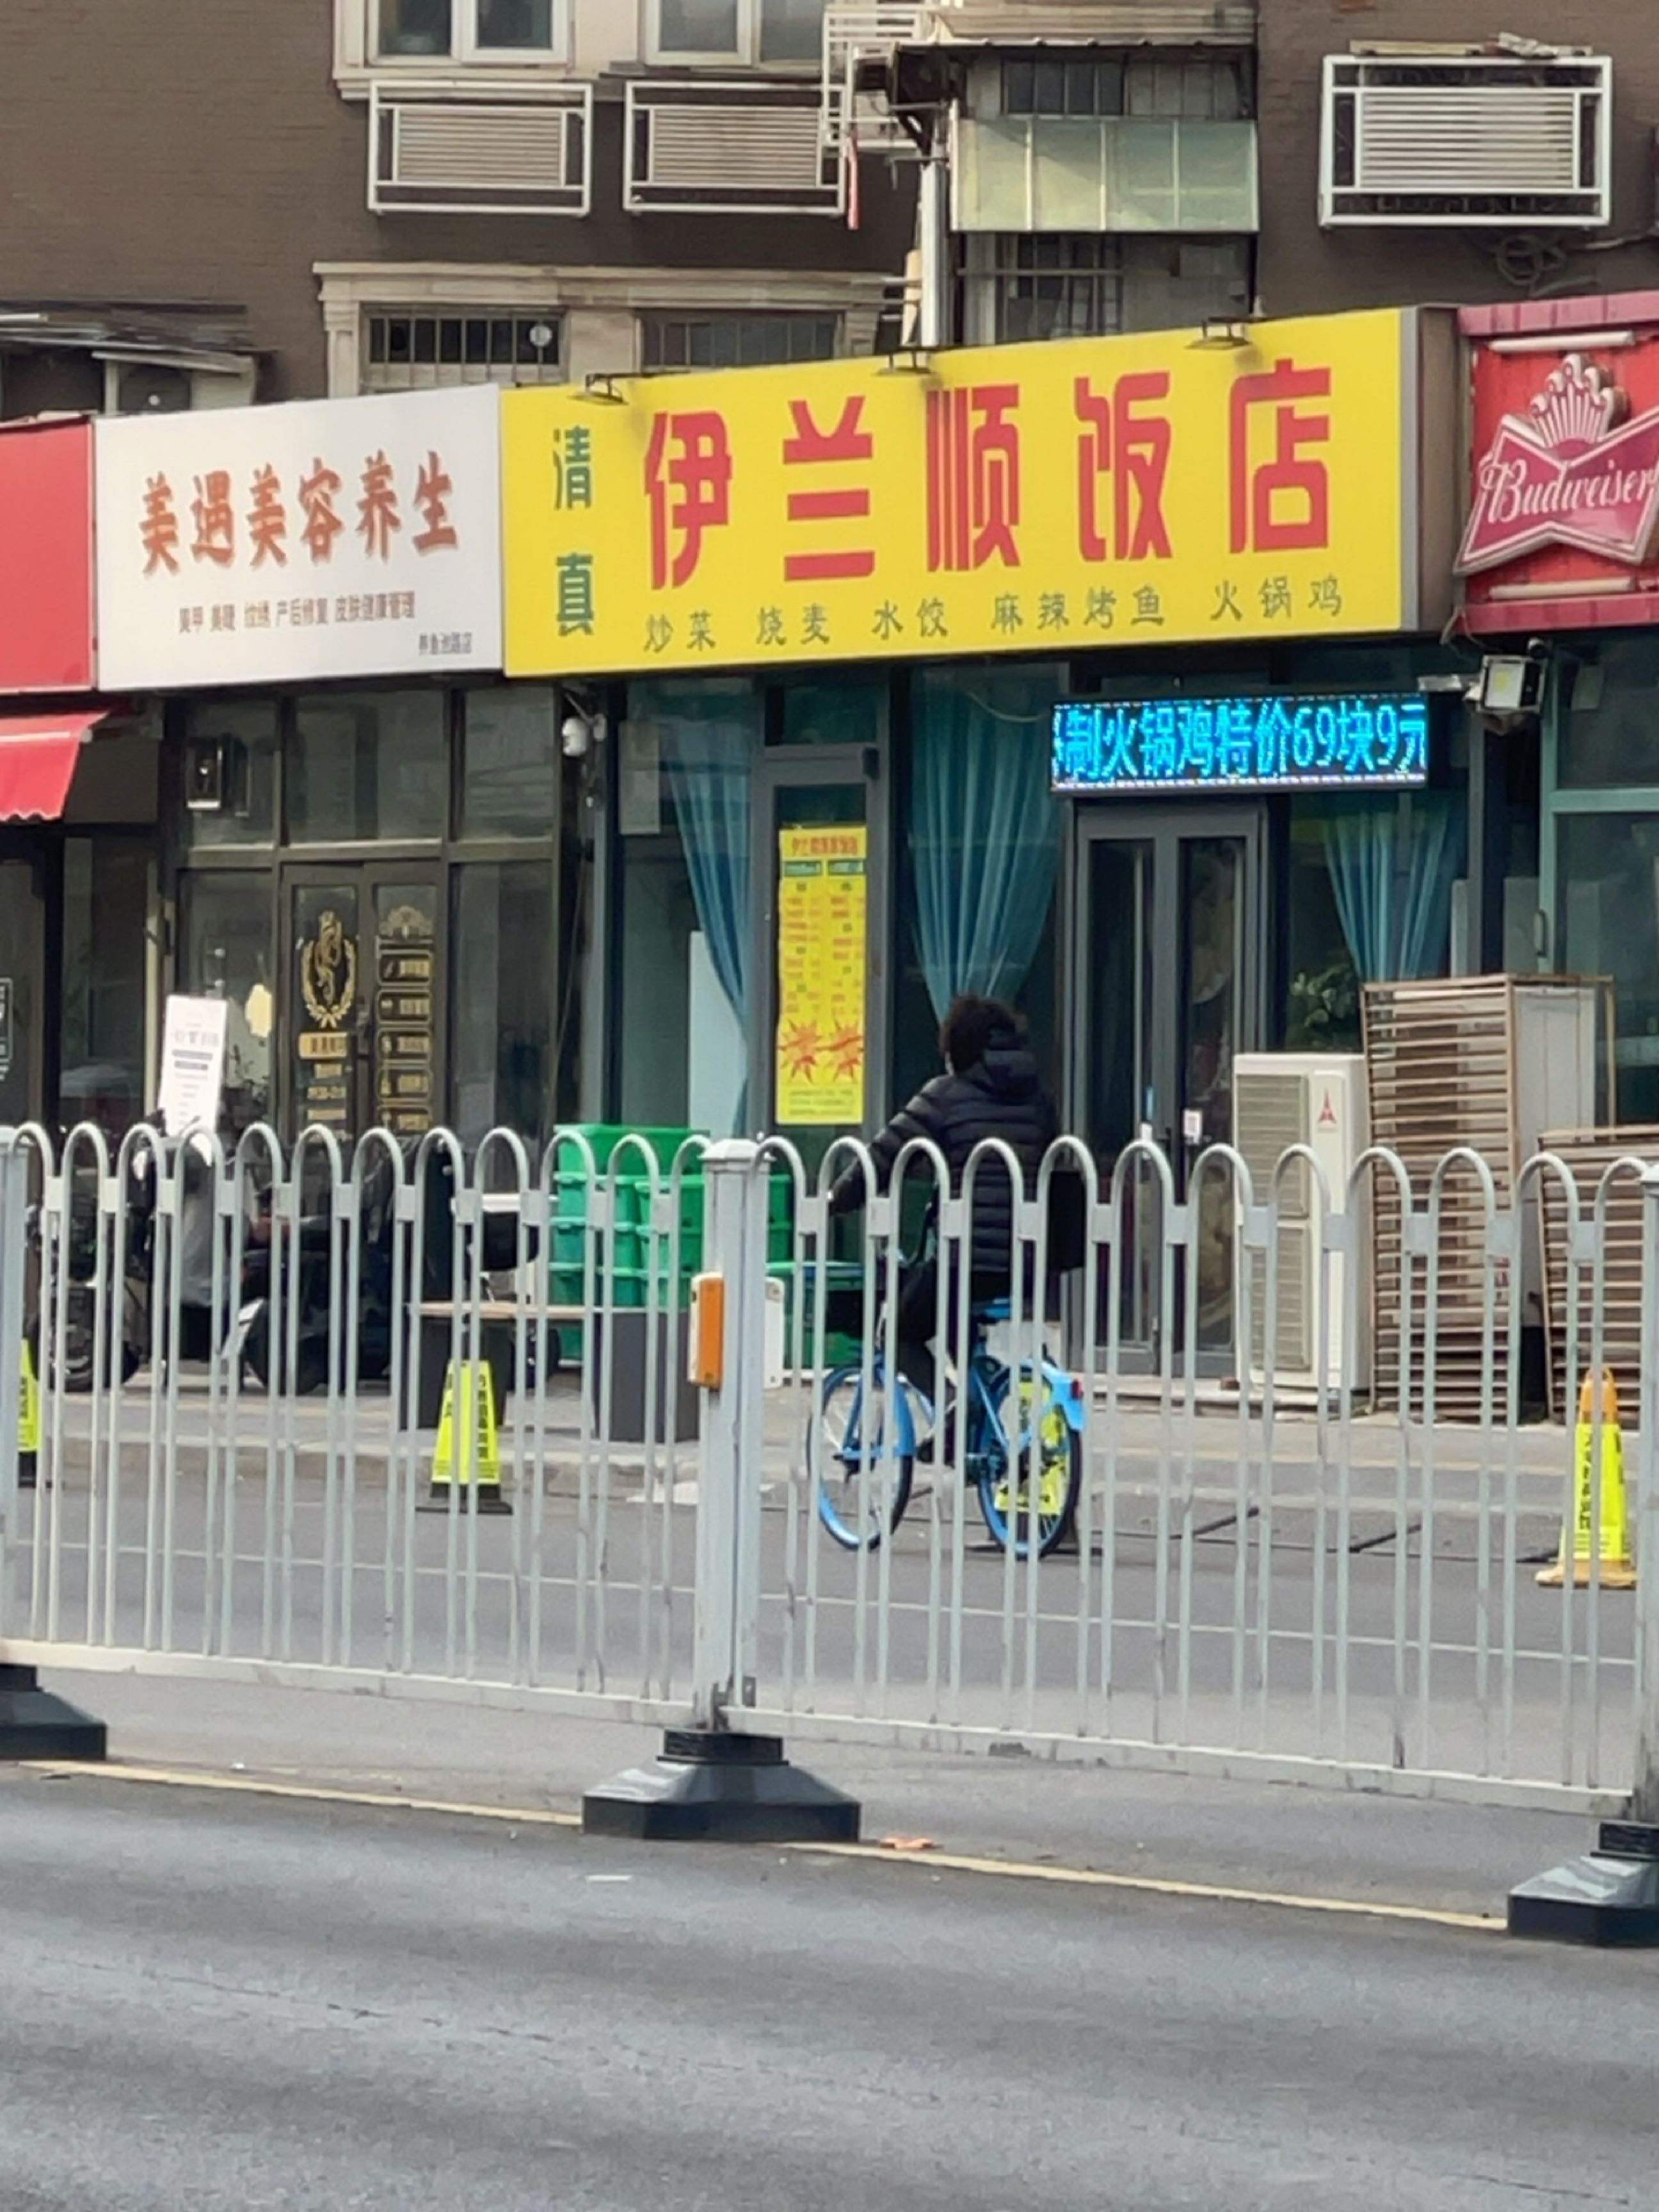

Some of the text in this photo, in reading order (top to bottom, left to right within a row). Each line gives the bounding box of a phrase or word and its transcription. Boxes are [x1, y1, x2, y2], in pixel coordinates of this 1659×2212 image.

[139, 449, 458, 577] 美遇美容养生
[553, 425, 595, 636] 清真
[644, 358, 1331, 590] 伊兰顺饭店
[1480, 458, 1658, 522] Budweiser
[643, 575, 1342, 652] 炒菜 烧麦 水饺 麻辣烤鱼 火锅鸡
